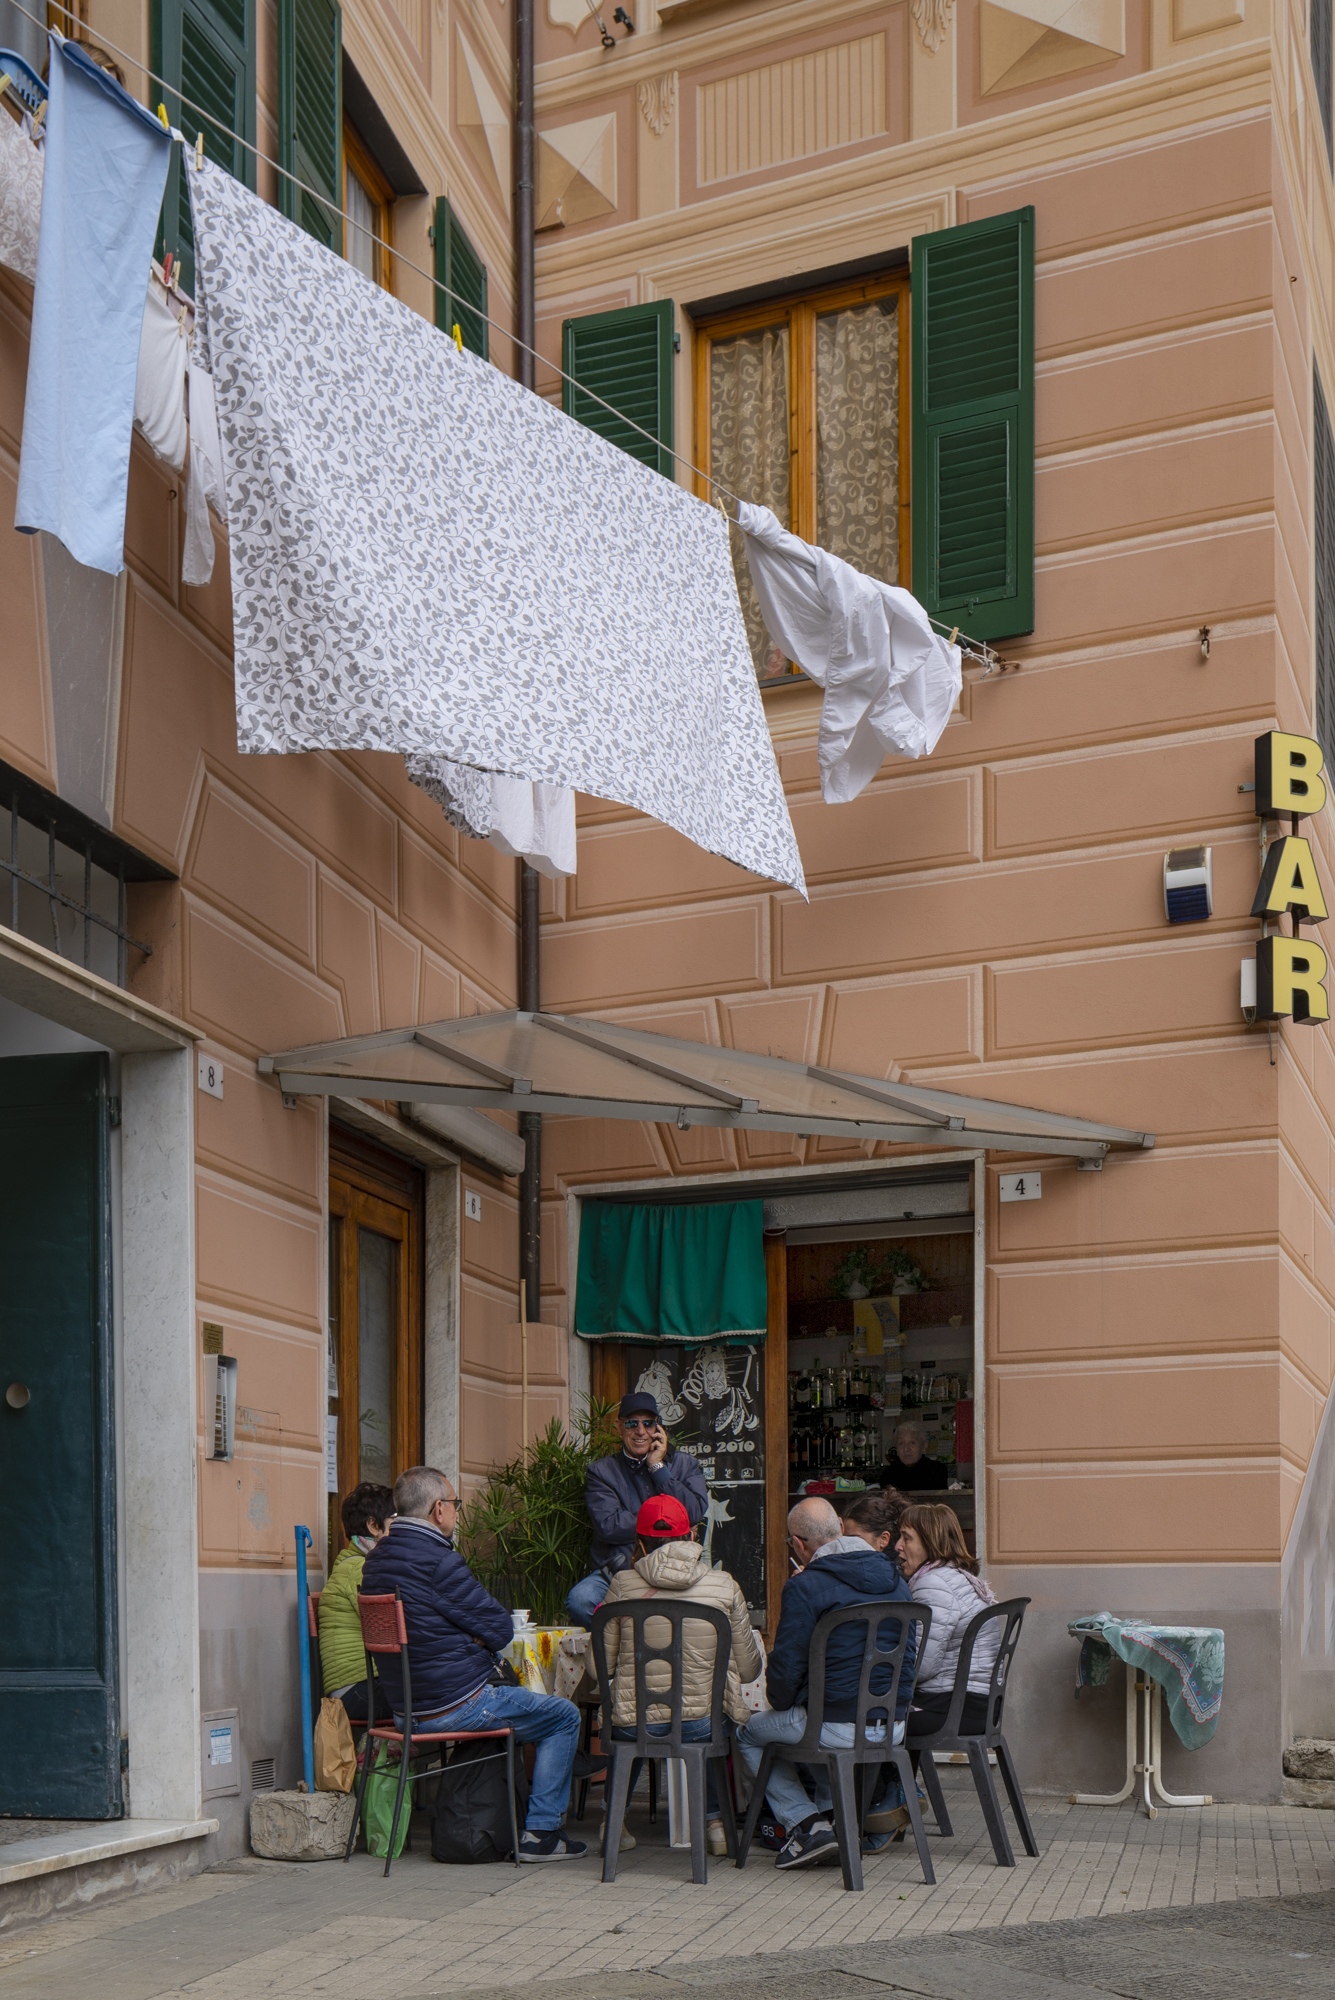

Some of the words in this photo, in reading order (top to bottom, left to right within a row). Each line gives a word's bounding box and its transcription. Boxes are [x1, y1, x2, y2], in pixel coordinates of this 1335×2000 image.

[1264, 730, 1330, 1022] BAR
[208, 1065, 215, 1088] 8
[1015, 1178, 1026, 1195] 4
[471, 1197, 476, 1214] 6
[716, 1440, 756, 1453] 2010
